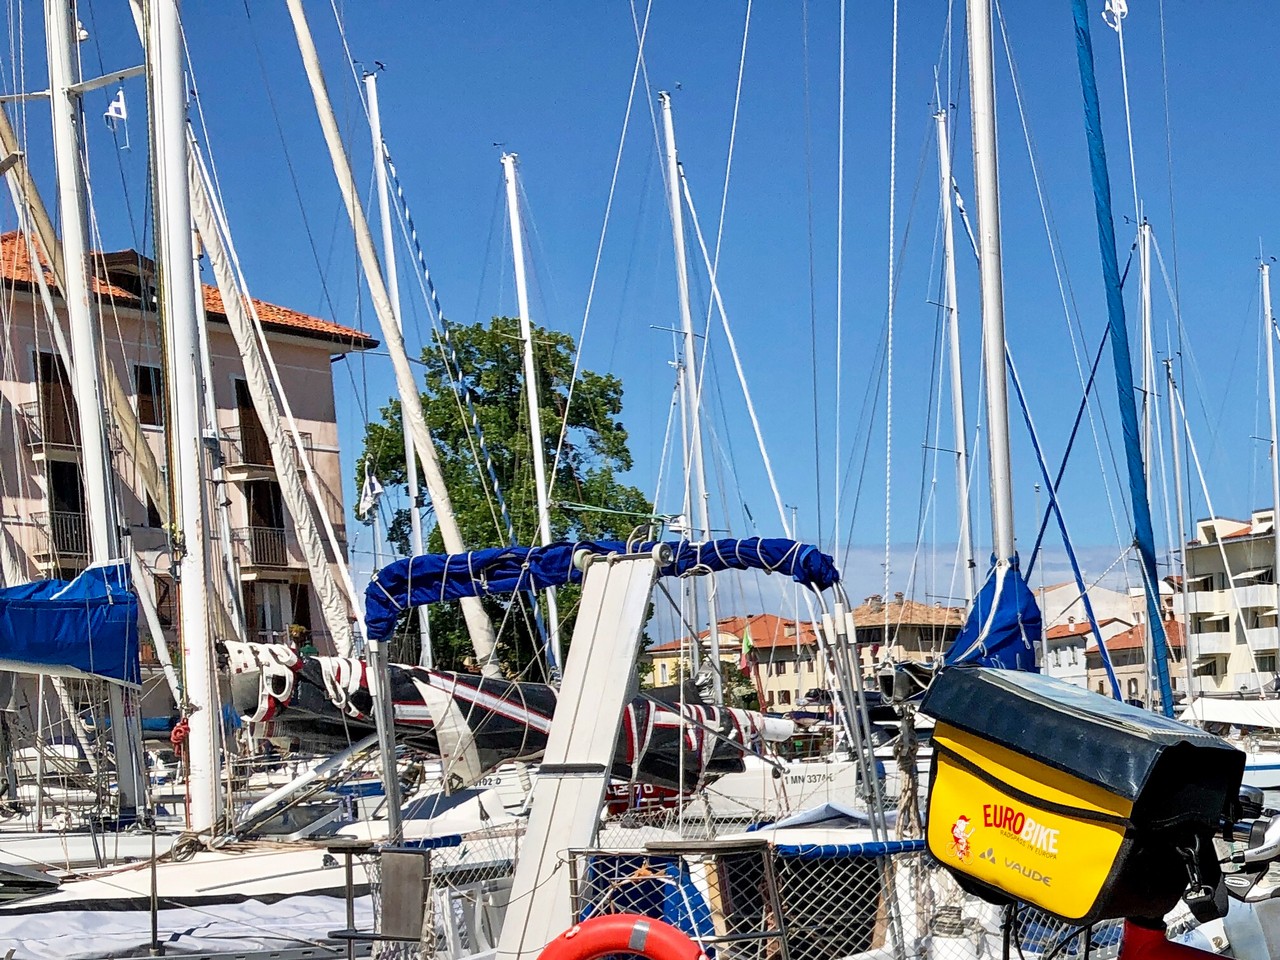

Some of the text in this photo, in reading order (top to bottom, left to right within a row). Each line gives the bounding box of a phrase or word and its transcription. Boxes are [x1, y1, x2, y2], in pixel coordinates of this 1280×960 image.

[983, 804, 1060, 854] EUROBIKE
[1034, 848, 1057, 860] EUROPA
[1004, 857, 1052, 887] VAUDE
